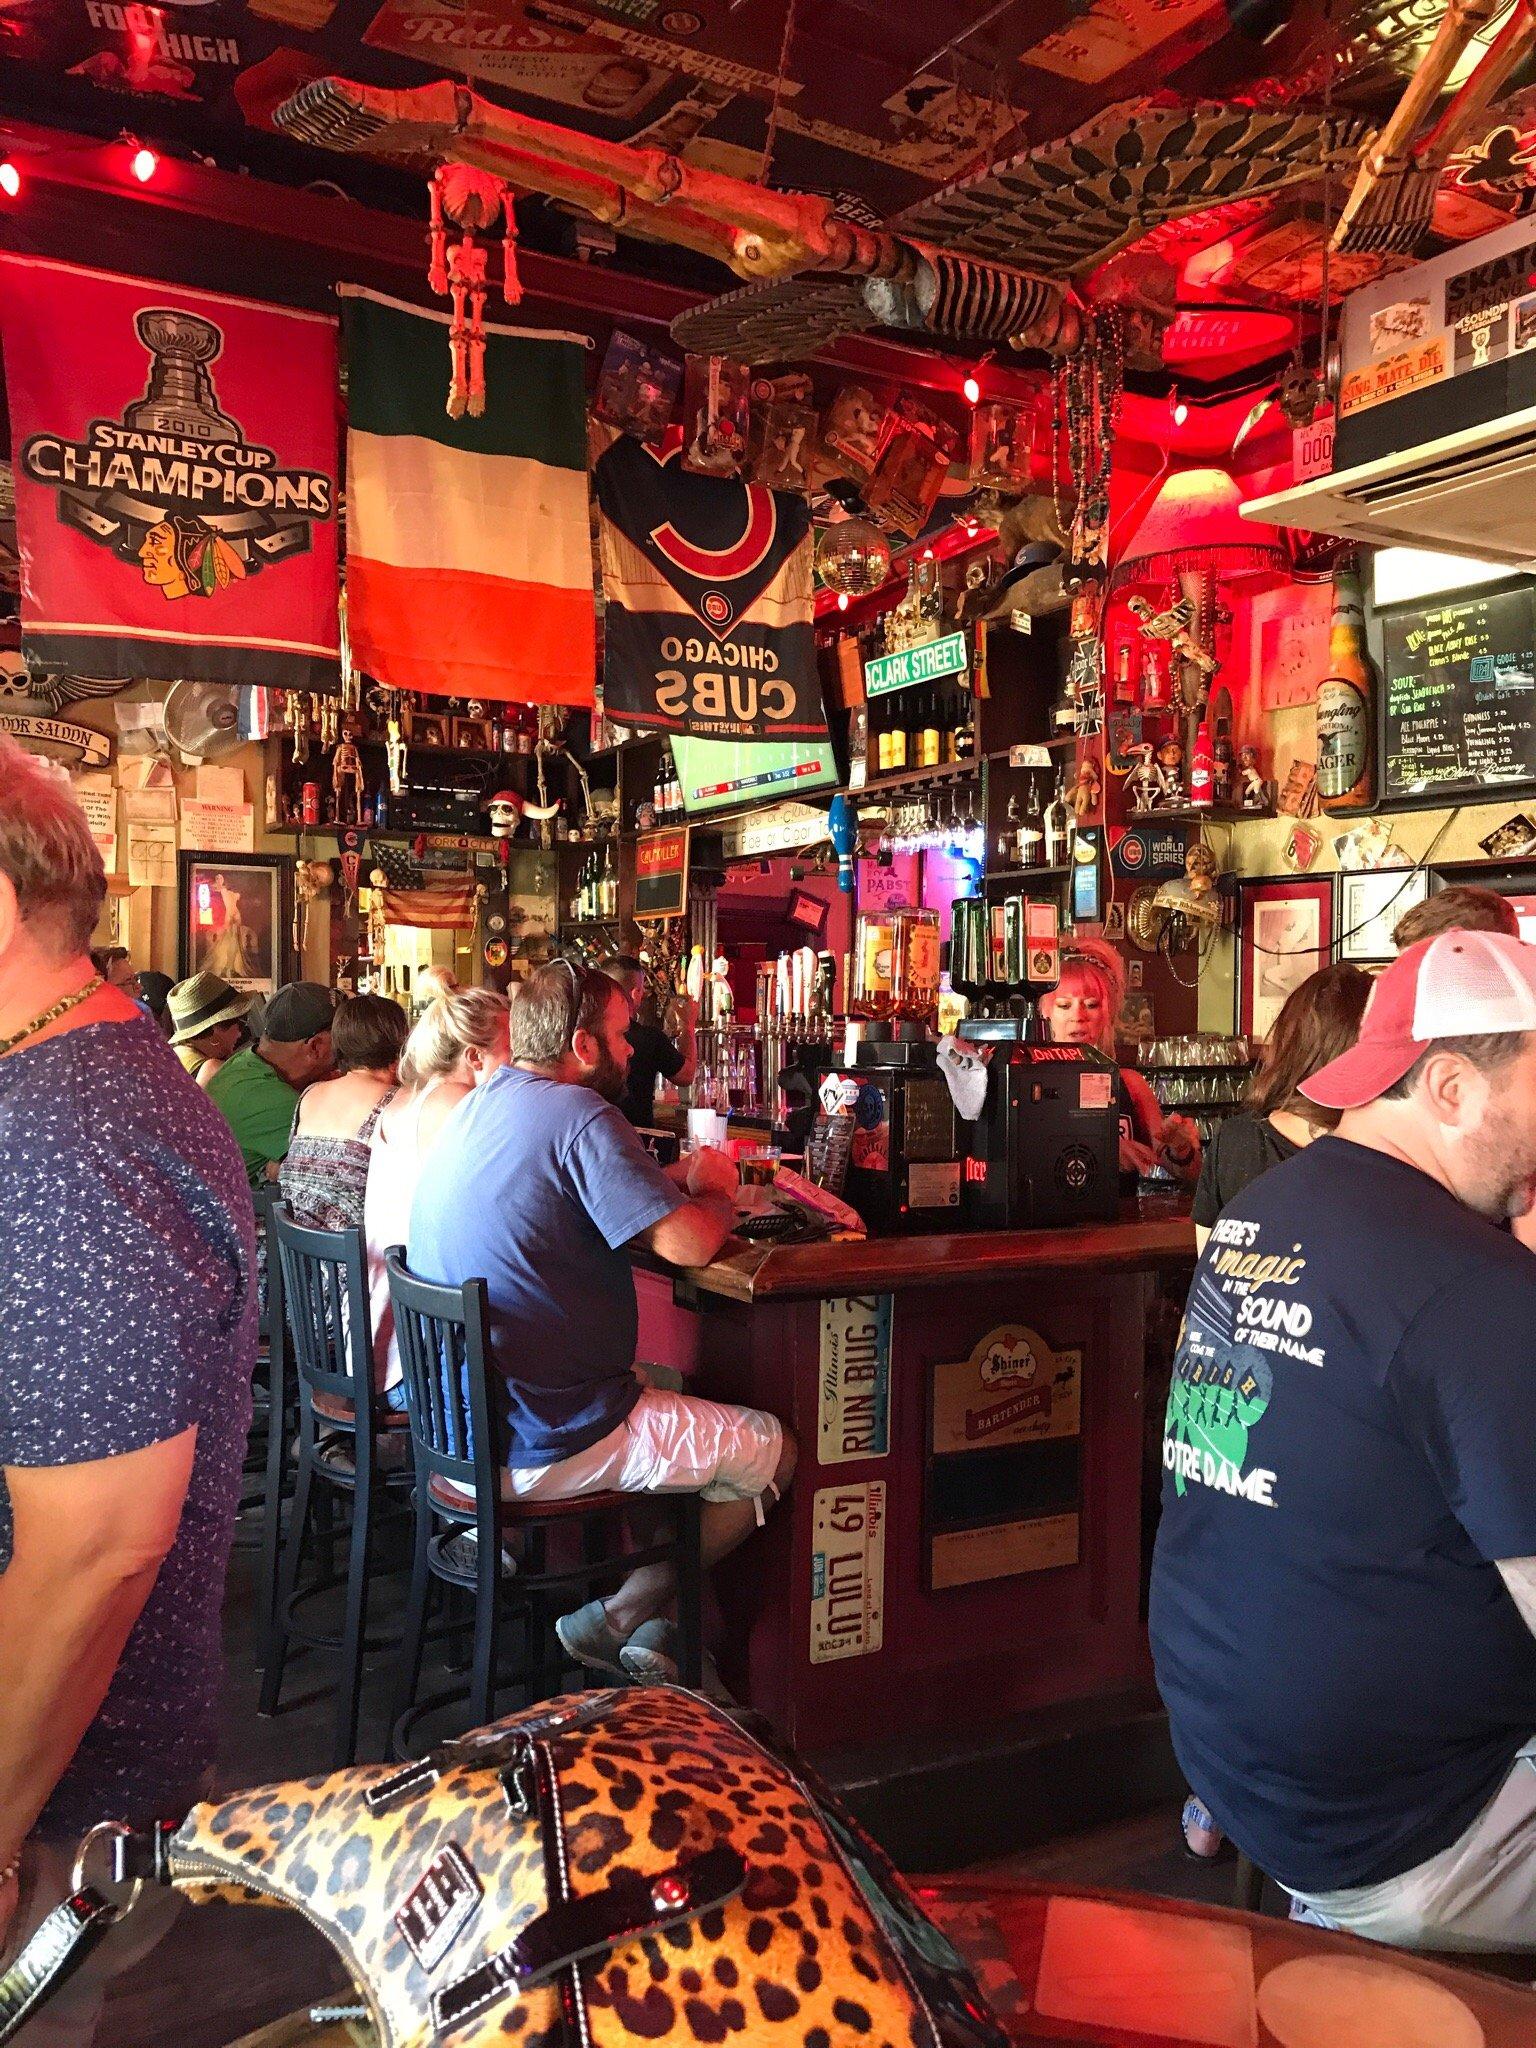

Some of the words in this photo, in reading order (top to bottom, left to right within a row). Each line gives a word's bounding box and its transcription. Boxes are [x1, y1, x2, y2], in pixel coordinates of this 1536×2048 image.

[156, 34, 241, 67] HIGH
[157, 417, 211, 438] 2010
[94, 425, 213, 461] STANLEY
[213, 445, 271, 470] CUP
[27, 439, 332, 514] CHAMPIONS
[871, 654, 911, 691] CLARK
[911, 638, 959, 680] STREET
[1316, 703, 1360, 721] uengling
[35, 720, 94, 747] SALOON
[1317, 752, 1356, 771] AGER
[470, 837, 499, 851] CITY
[1152, 842, 1185, 853] WORLD
[1152, 852, 1185, 866] SERIES
[1210, 1219, 1260, 1248] THERE'S
[1208, 1247, 1221, 1265] A
[1214, 1242, 1307, 1293] magic
[1221, 1279, 1232, 1293] IN
[1231, 1280, 1252, 1297] THE
[1236, 1295, 1313, 1338] SOUND
[843, 1323, 879, 1387] BUG
[991, 1353, 1031, 1375] Shiner
[1233, 1326, 1249, 1344] OF
[1277, 1337, 1326, 1368] NAME
[825, 1332, 840, 1403] Illinois
[842, 1395, 879, 1455] RUN
[977, 1394, 1041, 1431] BARTENDER
[1202, 1451, 1278, 1508] DAME
[830, 1494, 865, 1535] 49
[866, 1486, 882, 1539] Illinois
[827, 1551, 864, 1637] LULU
